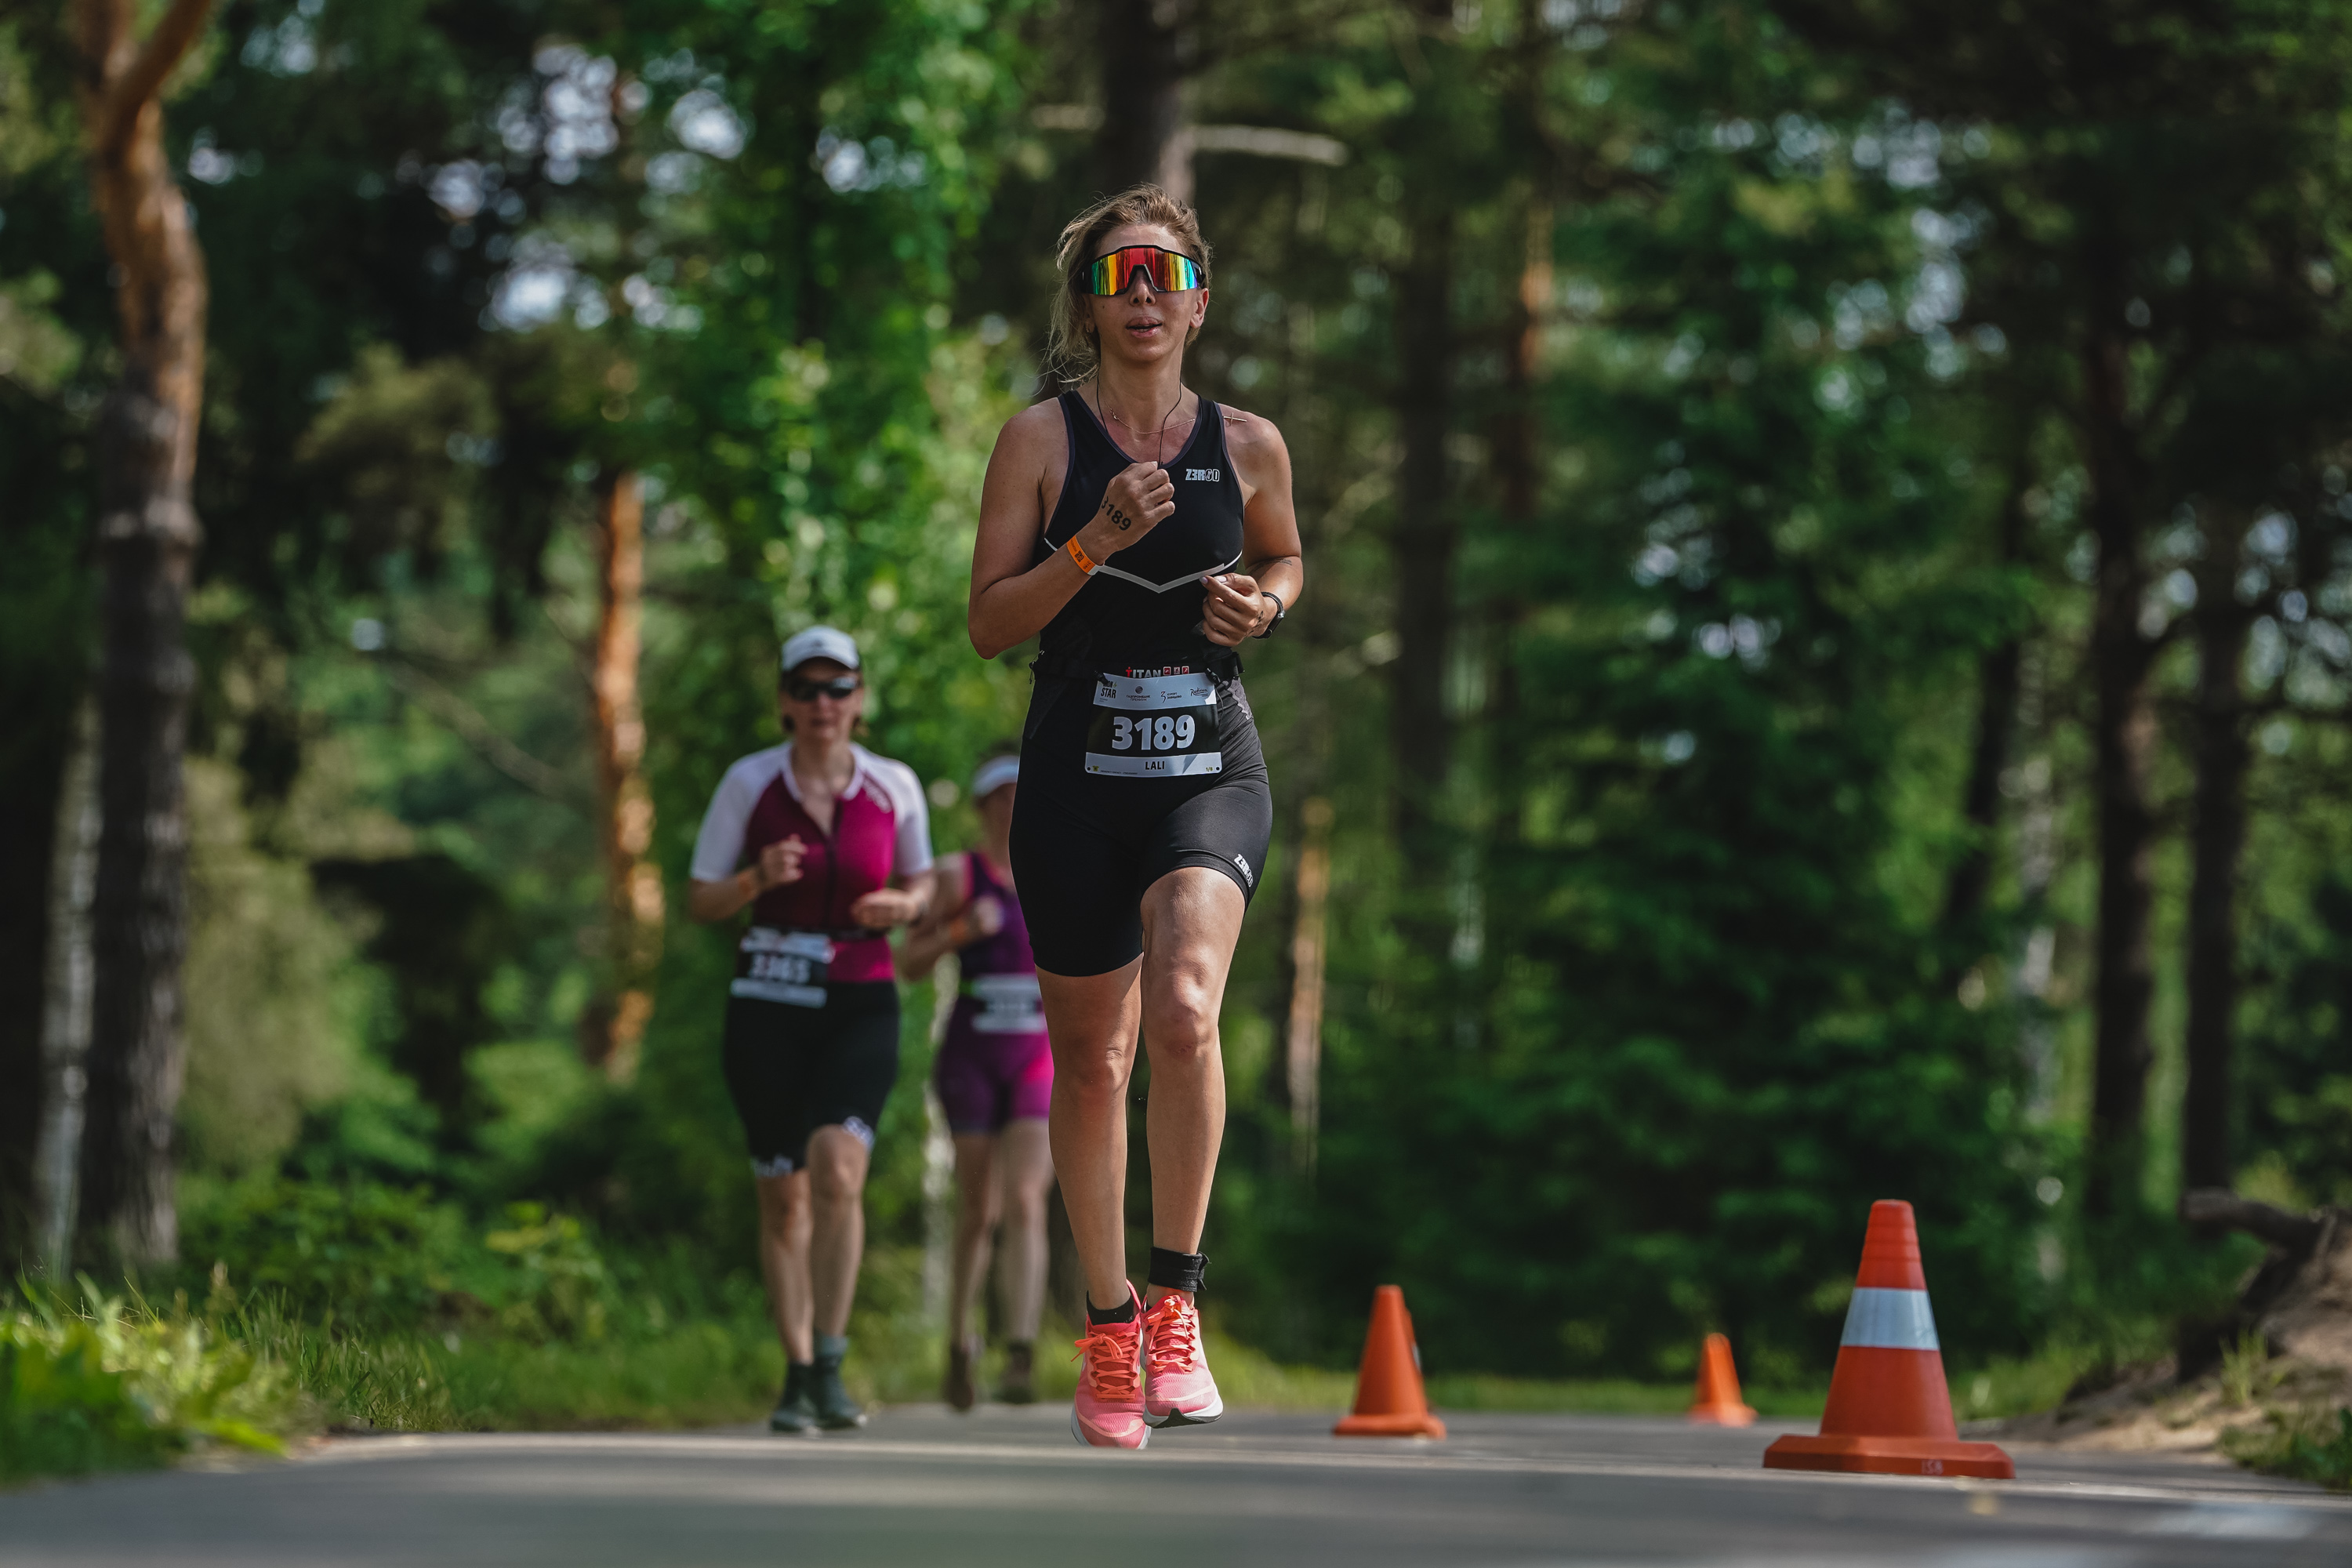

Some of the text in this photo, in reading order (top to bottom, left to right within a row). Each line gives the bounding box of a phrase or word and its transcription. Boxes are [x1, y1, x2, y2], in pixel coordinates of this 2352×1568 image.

[1101, 688, 1116, 699] STAR
[1112, 714, 1196, 750] 3189
[1145, 760, 1165, 770] LALI
